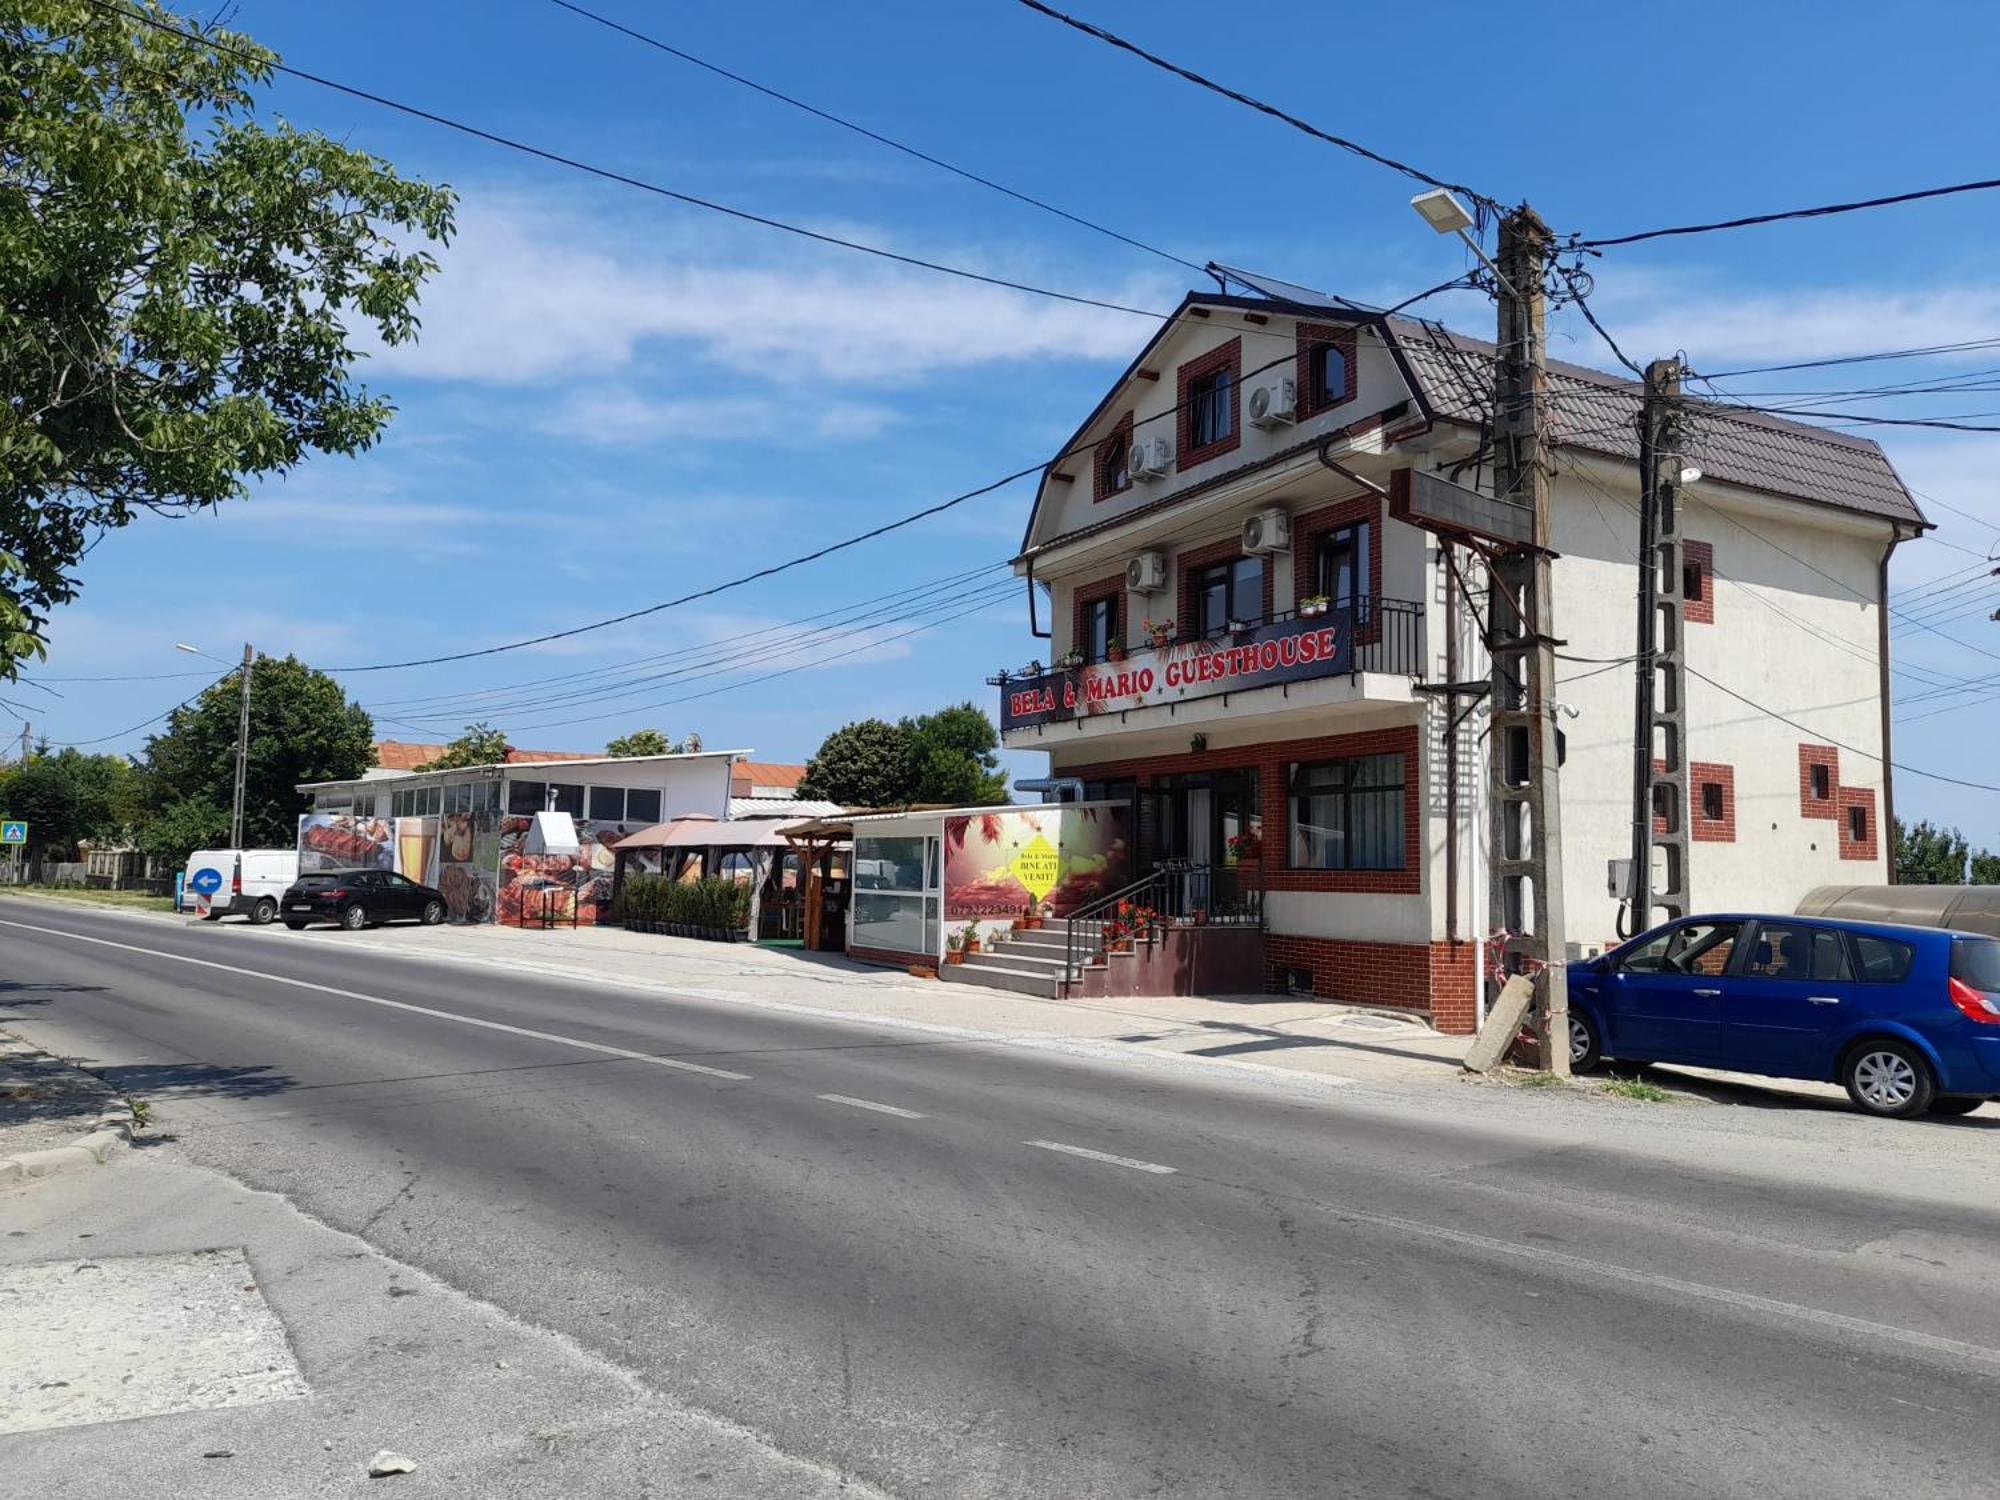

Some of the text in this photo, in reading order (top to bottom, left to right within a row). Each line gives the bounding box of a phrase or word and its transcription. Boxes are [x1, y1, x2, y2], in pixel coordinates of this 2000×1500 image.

[1011, 627, 1336, 716] BELA & MARIO GUESTHOUSE
[1020, 862, 1041, 870] BINE
